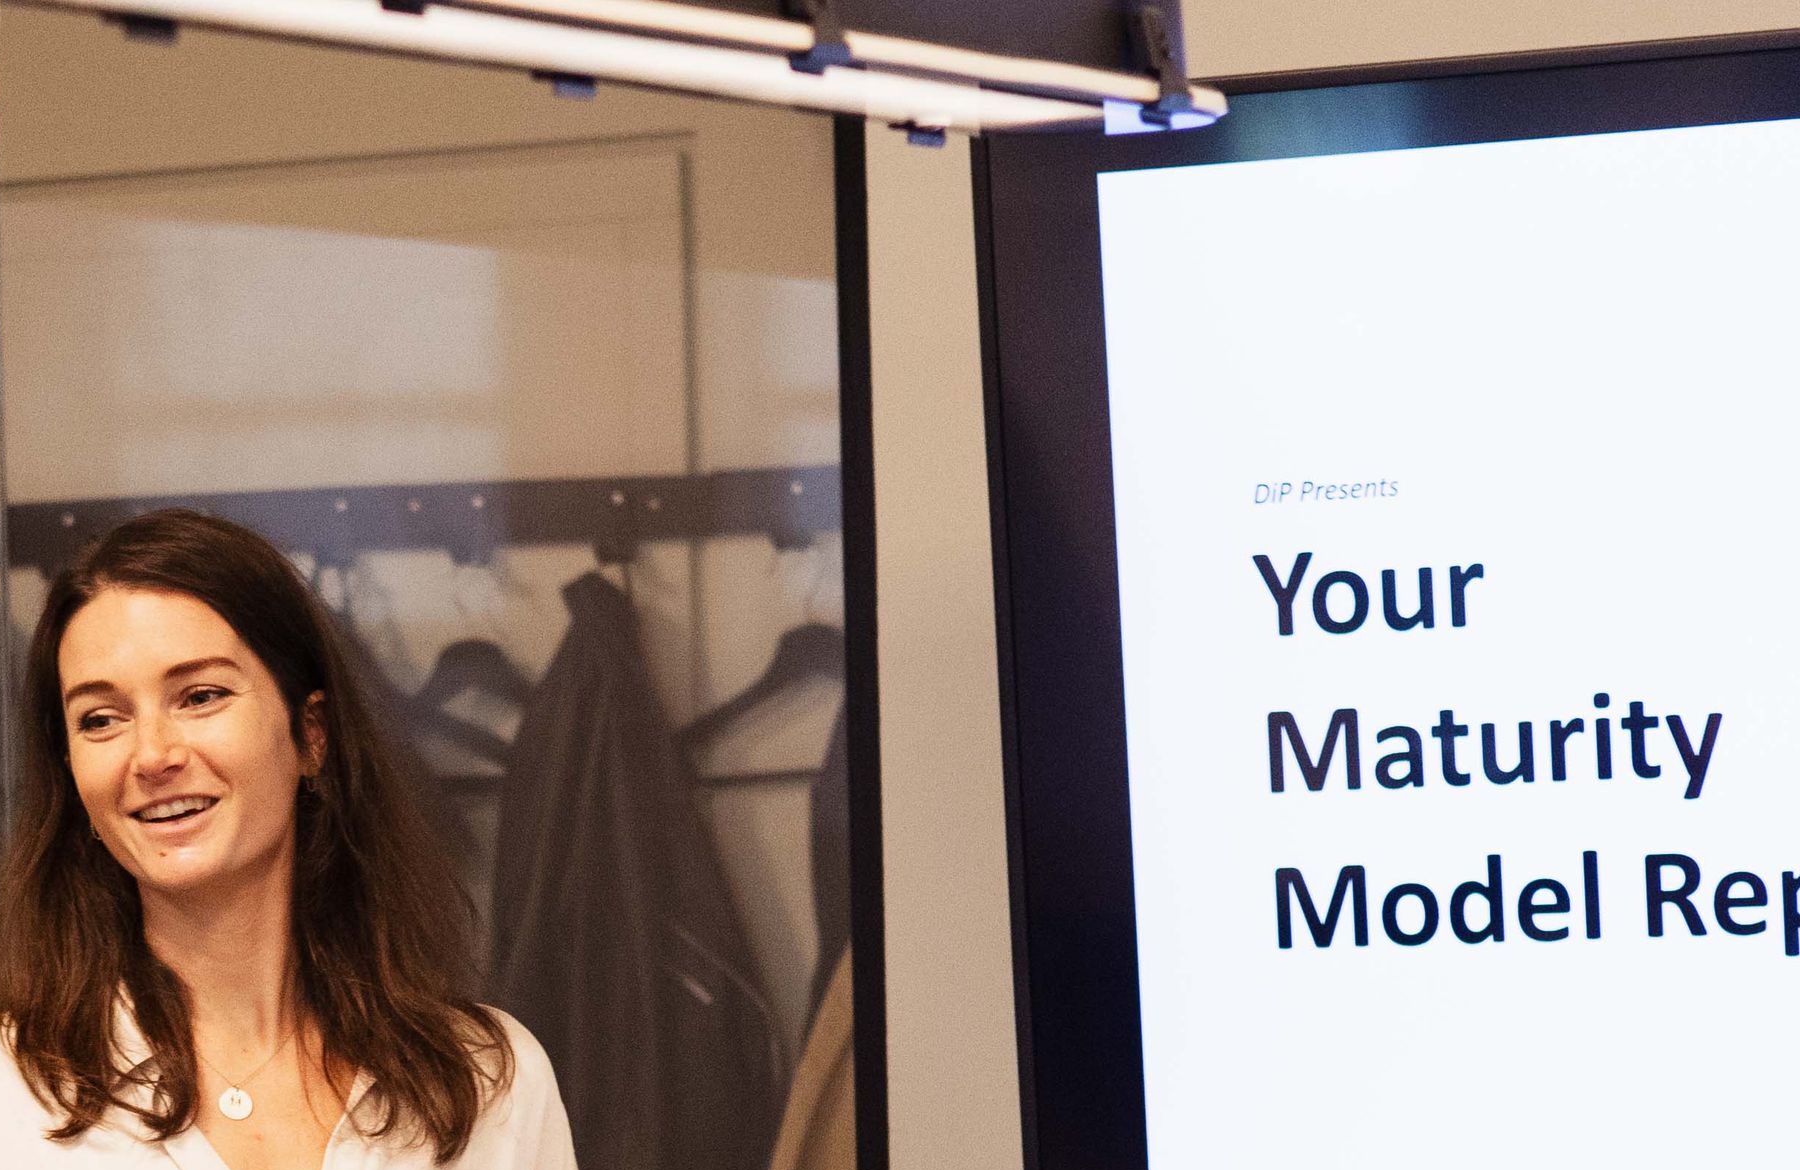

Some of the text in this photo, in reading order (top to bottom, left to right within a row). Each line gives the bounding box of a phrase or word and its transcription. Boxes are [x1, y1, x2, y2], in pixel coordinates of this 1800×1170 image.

[1254, 479, 1398, 504] DiP Presents
[1253, 552, 1483, 636] Your
[1268, 693, 1722, 799] Maturity
[1275, 851, 1600, 949] Model
